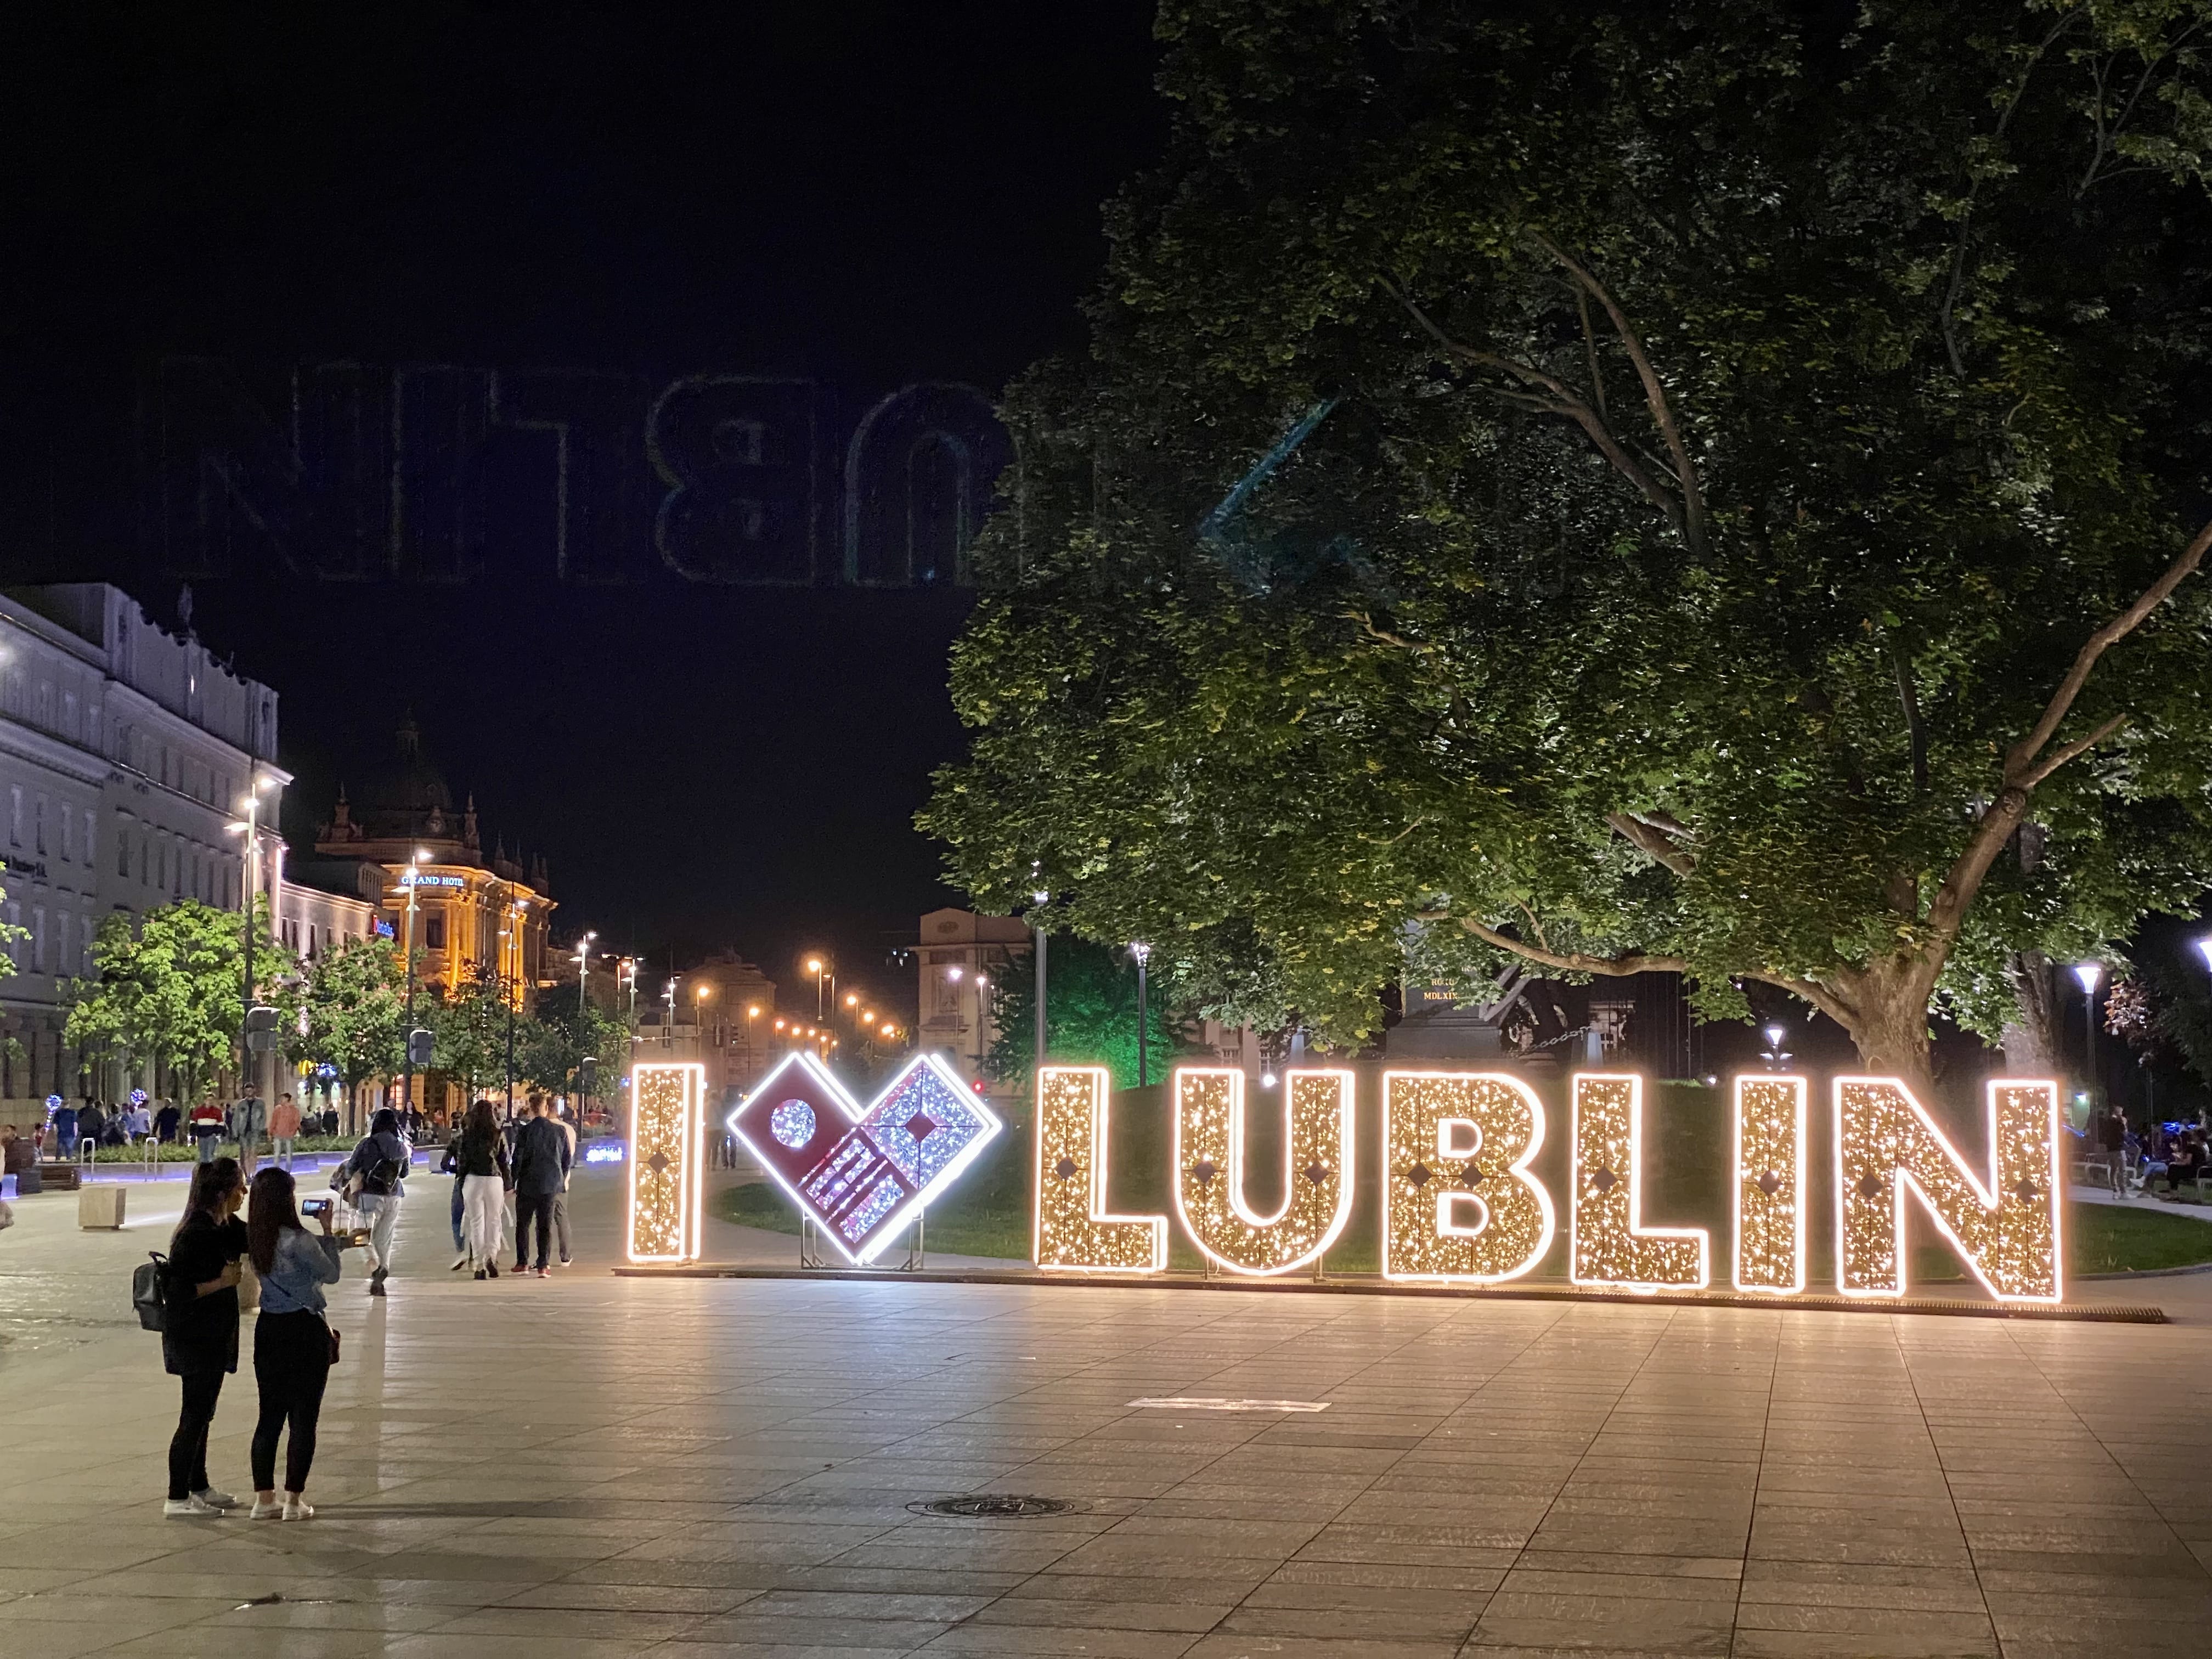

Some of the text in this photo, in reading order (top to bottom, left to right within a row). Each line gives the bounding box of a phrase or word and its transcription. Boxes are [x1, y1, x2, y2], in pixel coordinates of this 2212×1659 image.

[401, 876, 439, 885] GRAND
[628, 1063, 2064, 1304] I LUBLIN
